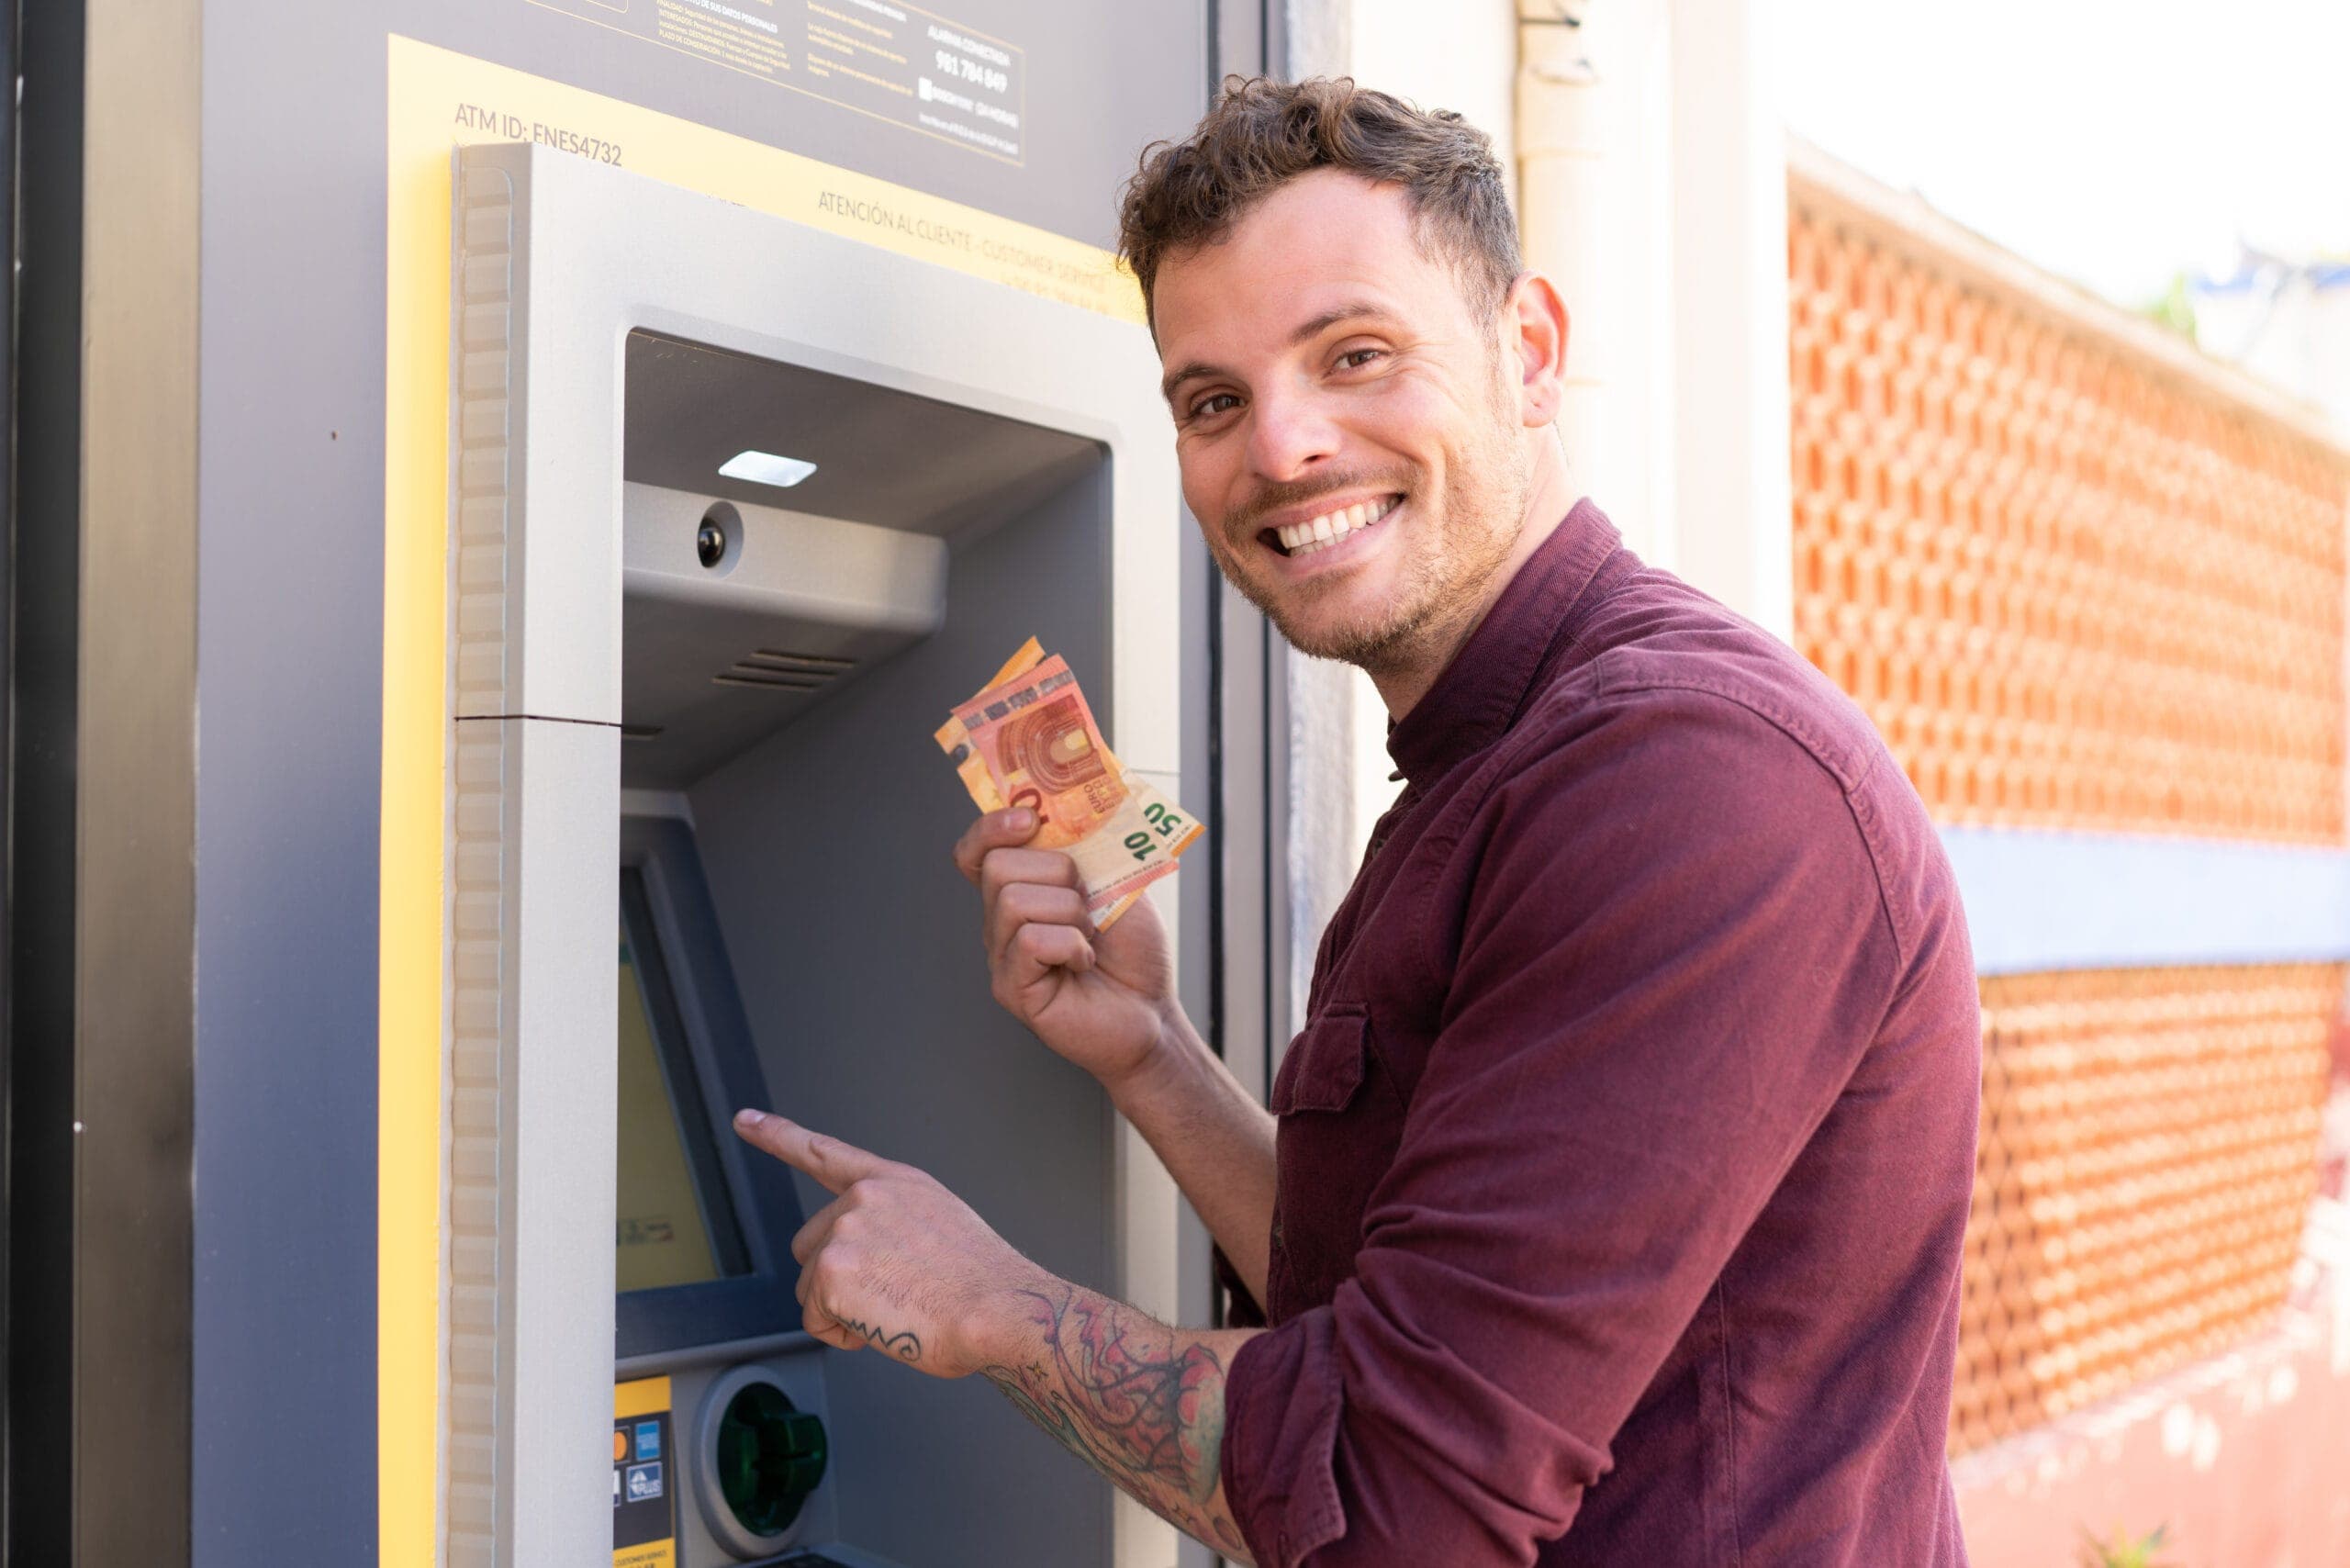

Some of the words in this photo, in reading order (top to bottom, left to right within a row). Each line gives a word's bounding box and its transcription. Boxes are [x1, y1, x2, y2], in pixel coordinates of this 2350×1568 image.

[455, 103, 497, 134] ATM
[532, 122, 622, 168] ENES4732
[818, 190, 894, 229] ATENCIÓN
[896, 213, 915, 236] AL
[1144, 802, 1182, 837] 50
[1124, 831, 1158, 861] 10
